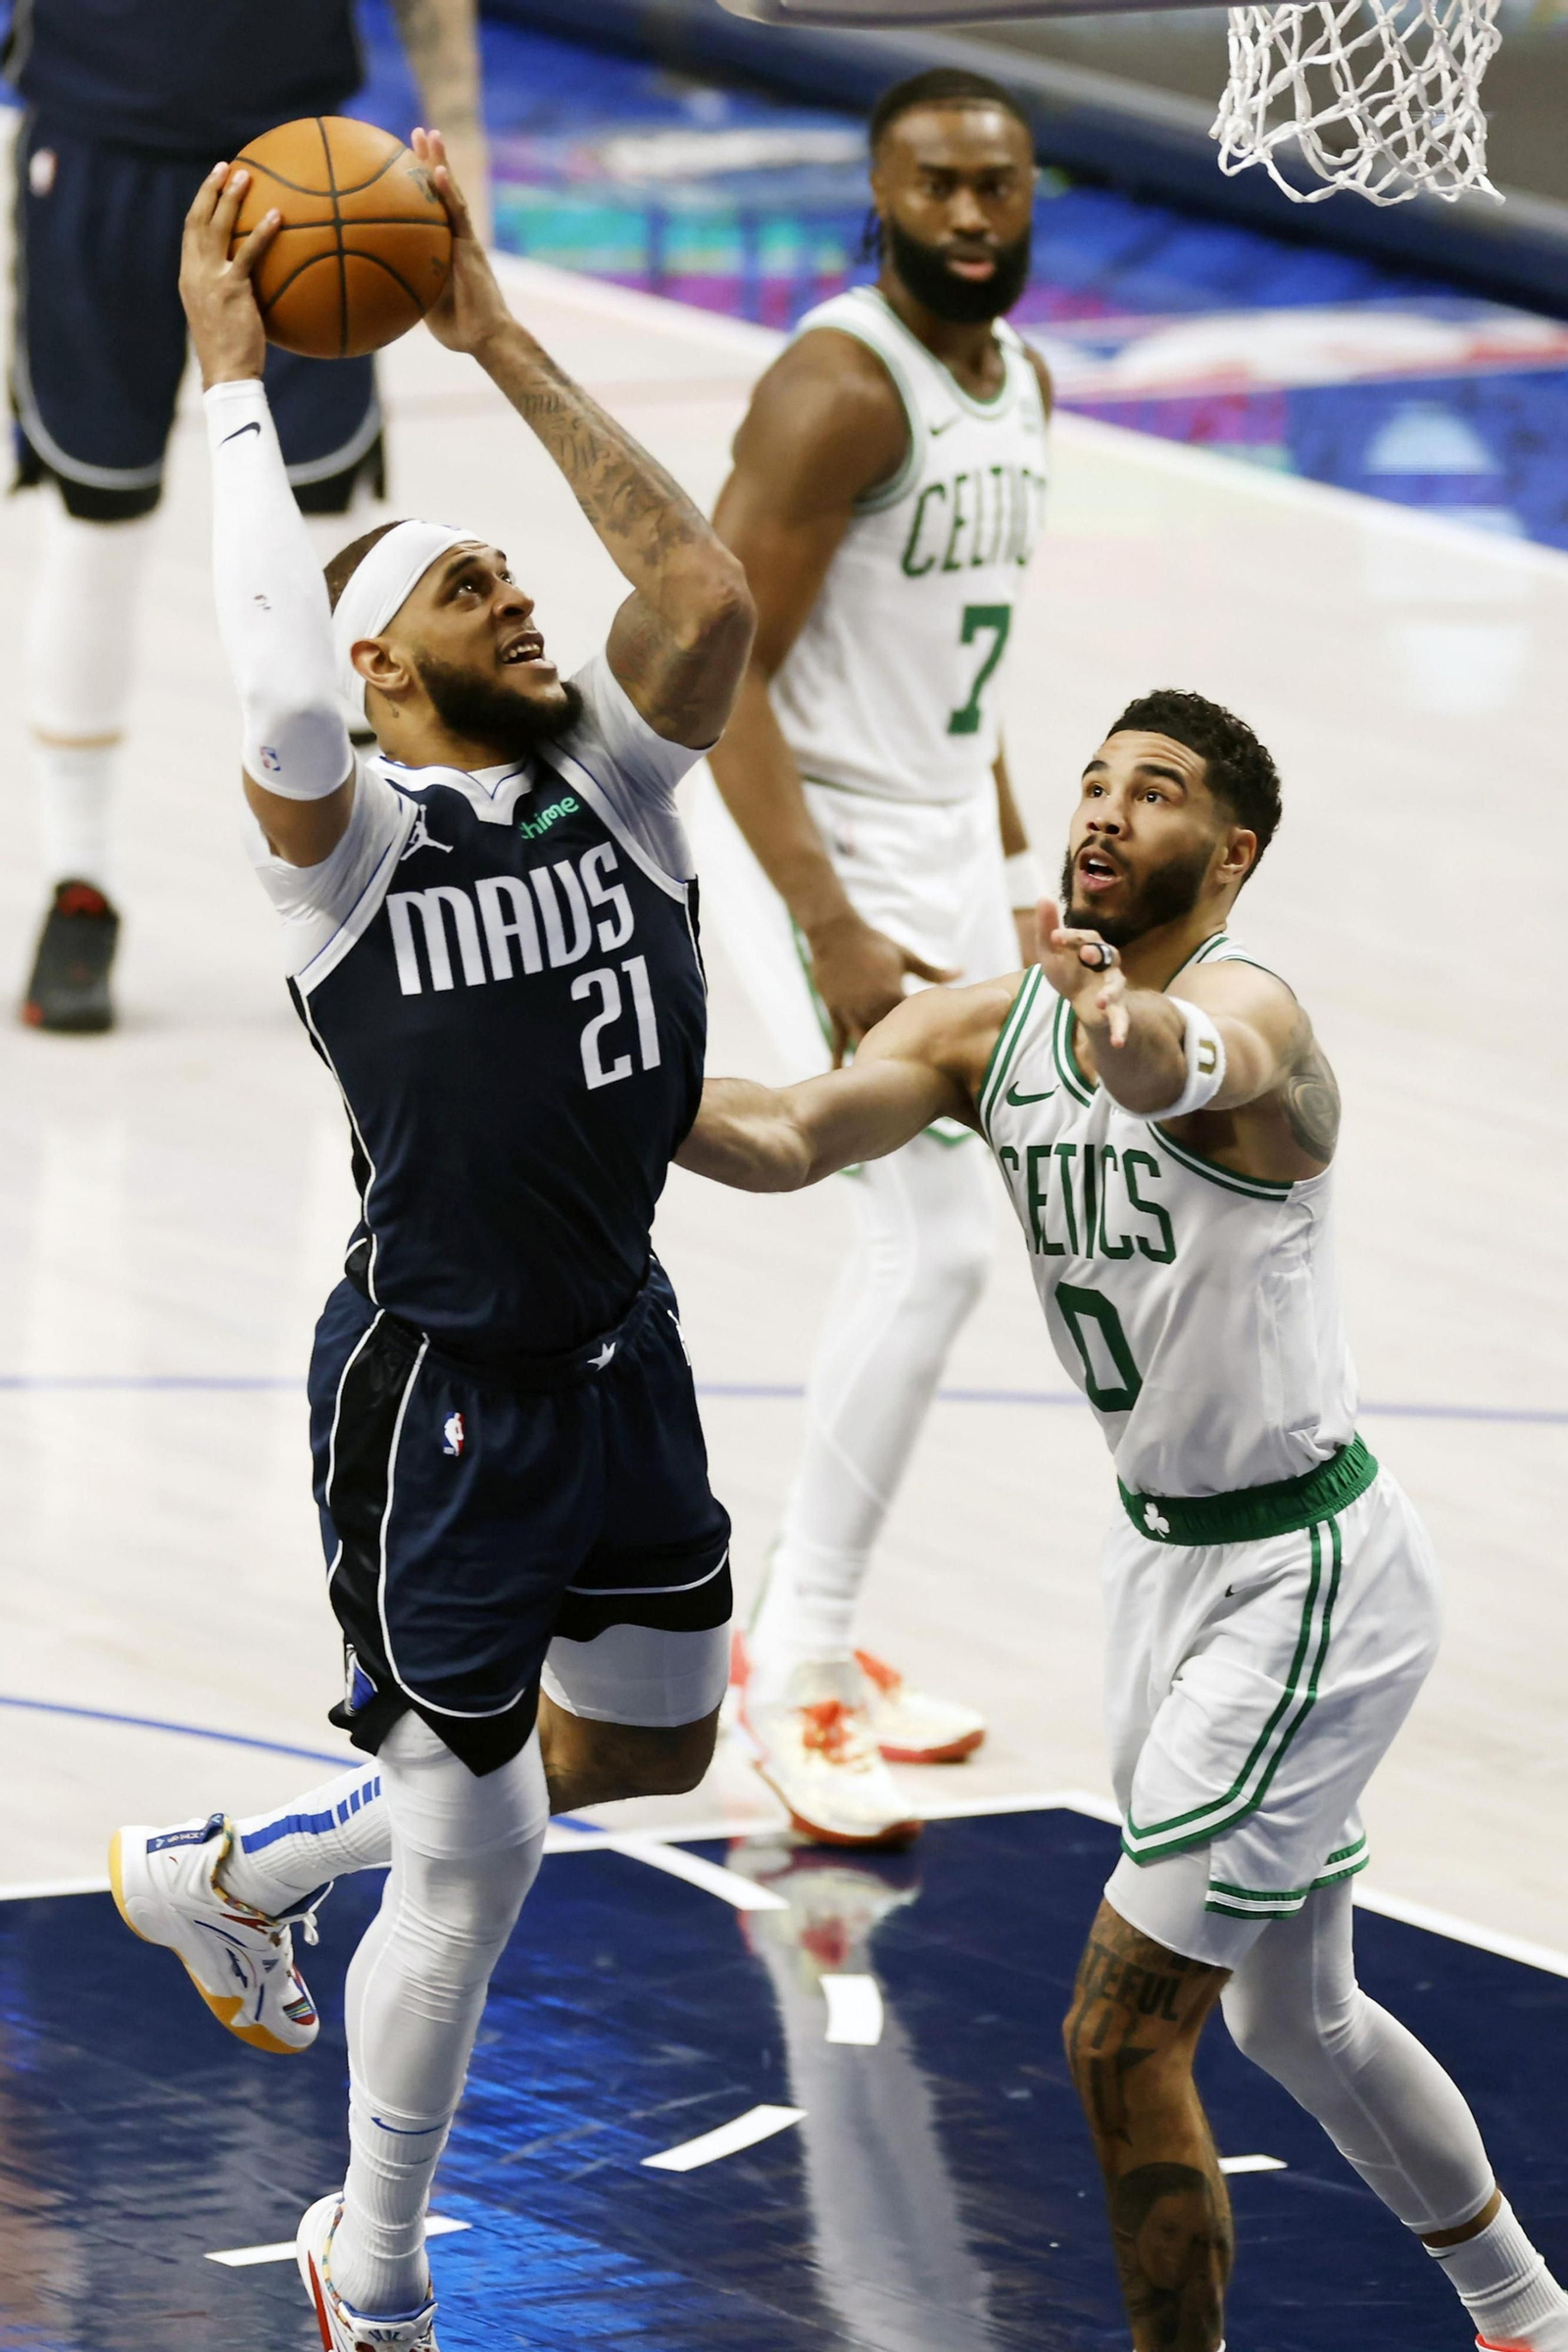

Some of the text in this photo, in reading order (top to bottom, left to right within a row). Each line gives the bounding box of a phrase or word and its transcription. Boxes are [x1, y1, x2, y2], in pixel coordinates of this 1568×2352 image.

[947, 605, 1010, 734] 7
[386, 841, 635, 996] MAVS
[570, 955, 662, 1091] 21
[1054, 1282, 1144, 1412] 0
